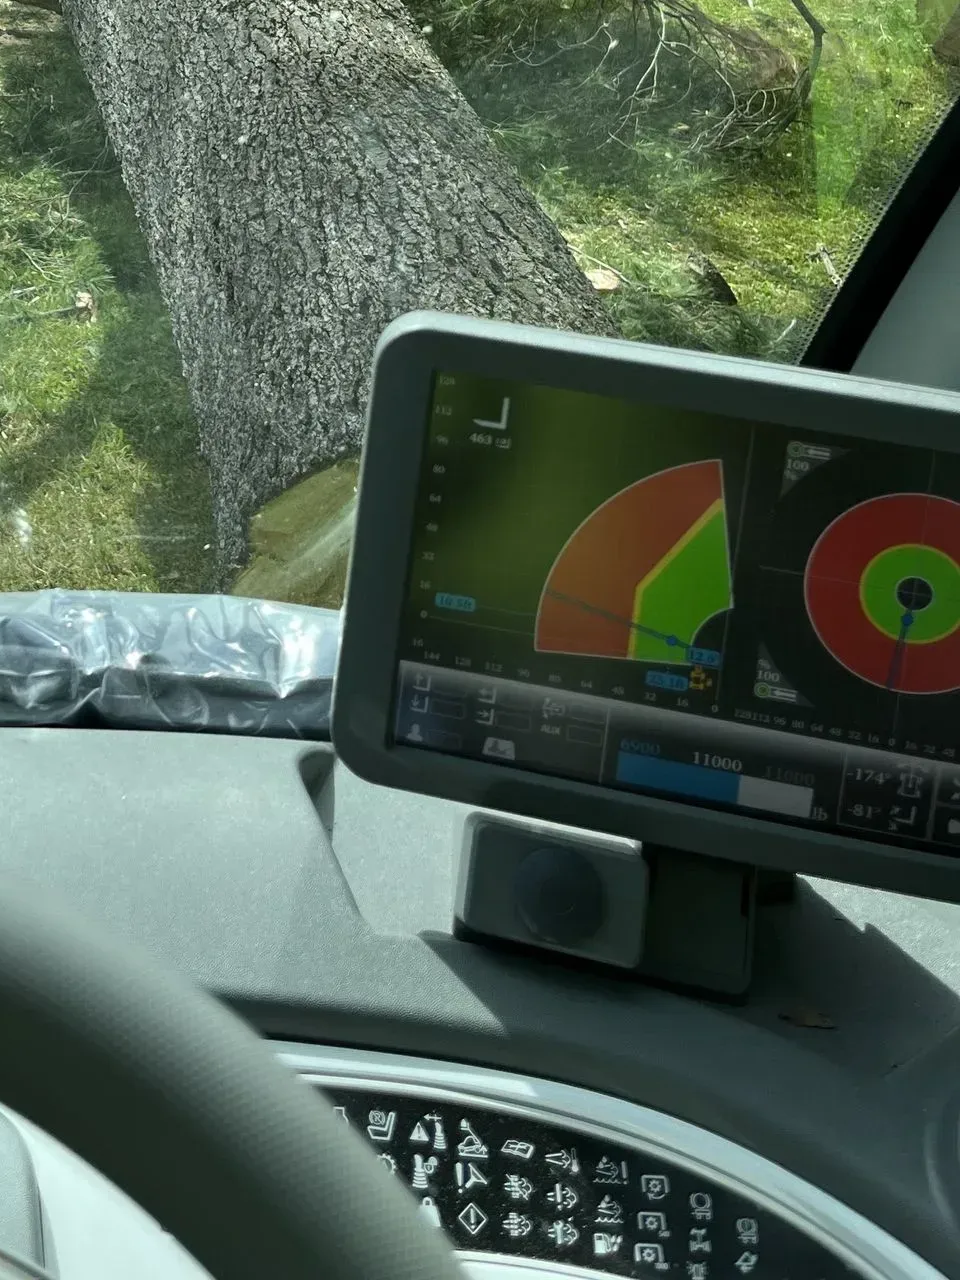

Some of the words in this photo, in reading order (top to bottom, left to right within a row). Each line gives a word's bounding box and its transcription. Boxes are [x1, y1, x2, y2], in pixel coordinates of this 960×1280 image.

[469, 432, 493, 446] 463
[786, 459, 810, 472] 100
[757, 670, 780, 682] 100
[692, 751, 743, 772] 11000
[764, 765, 816, 786] 11000
